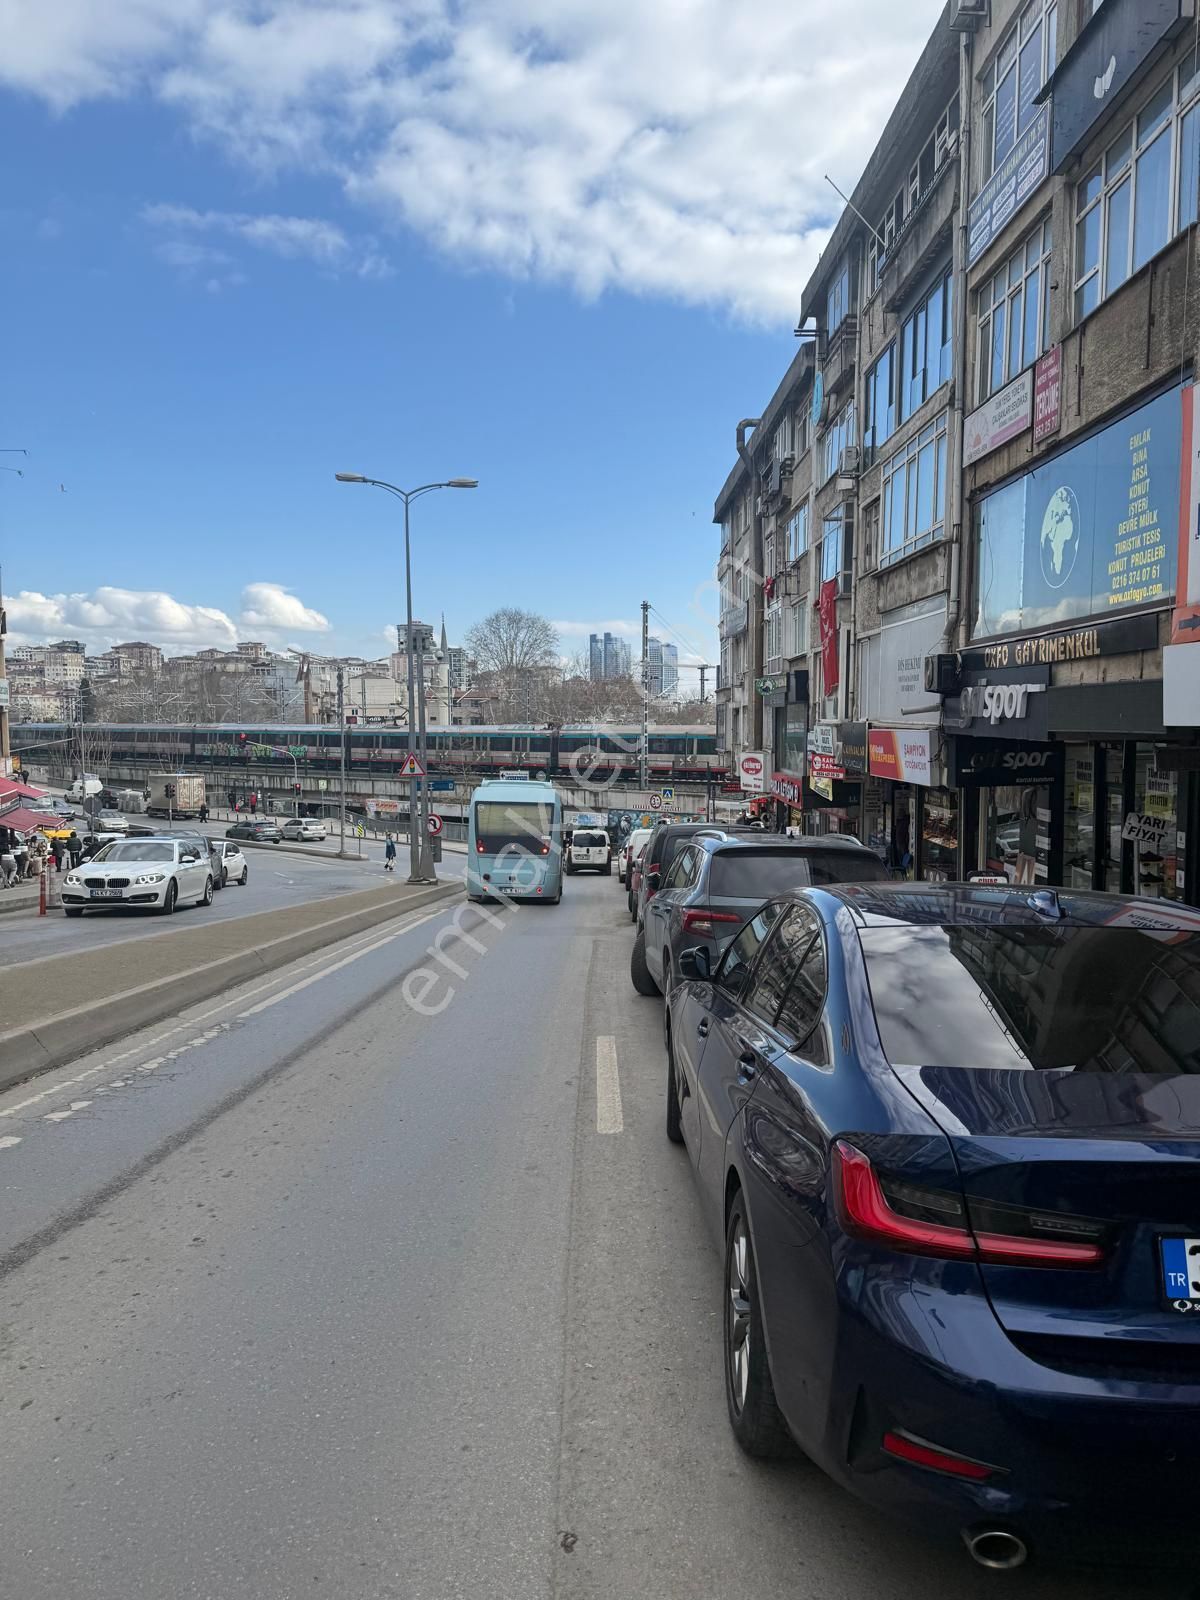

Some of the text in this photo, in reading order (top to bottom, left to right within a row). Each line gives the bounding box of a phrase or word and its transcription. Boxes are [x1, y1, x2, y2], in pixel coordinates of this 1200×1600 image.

[1130, 428, 1151, 450] EMLAK
[1132, 464, 1148, 484] ARSA
[1130, 478, 1150, 499] KONUT
[1119, 509, 1158, 536] DEVRE MÜLK
[1143, 528, 1161, 546] TESİS
[1108, 544, 1166, 576] KONUT PROJELERİ
[1112, 574, 1127, 589] 0216
[1129, 570, 1140, 585] 374
[1152, 564, 1160, 579] 61
[984, 645, 1009, 669] OXFO
[904, 742, 926, 758] ŞAMPİYON
[1136, 814, 1166, 830] YARI
[1127, 825, 1167, 843] FİYAT
[1168, 1273, 1186, 1287] TR
